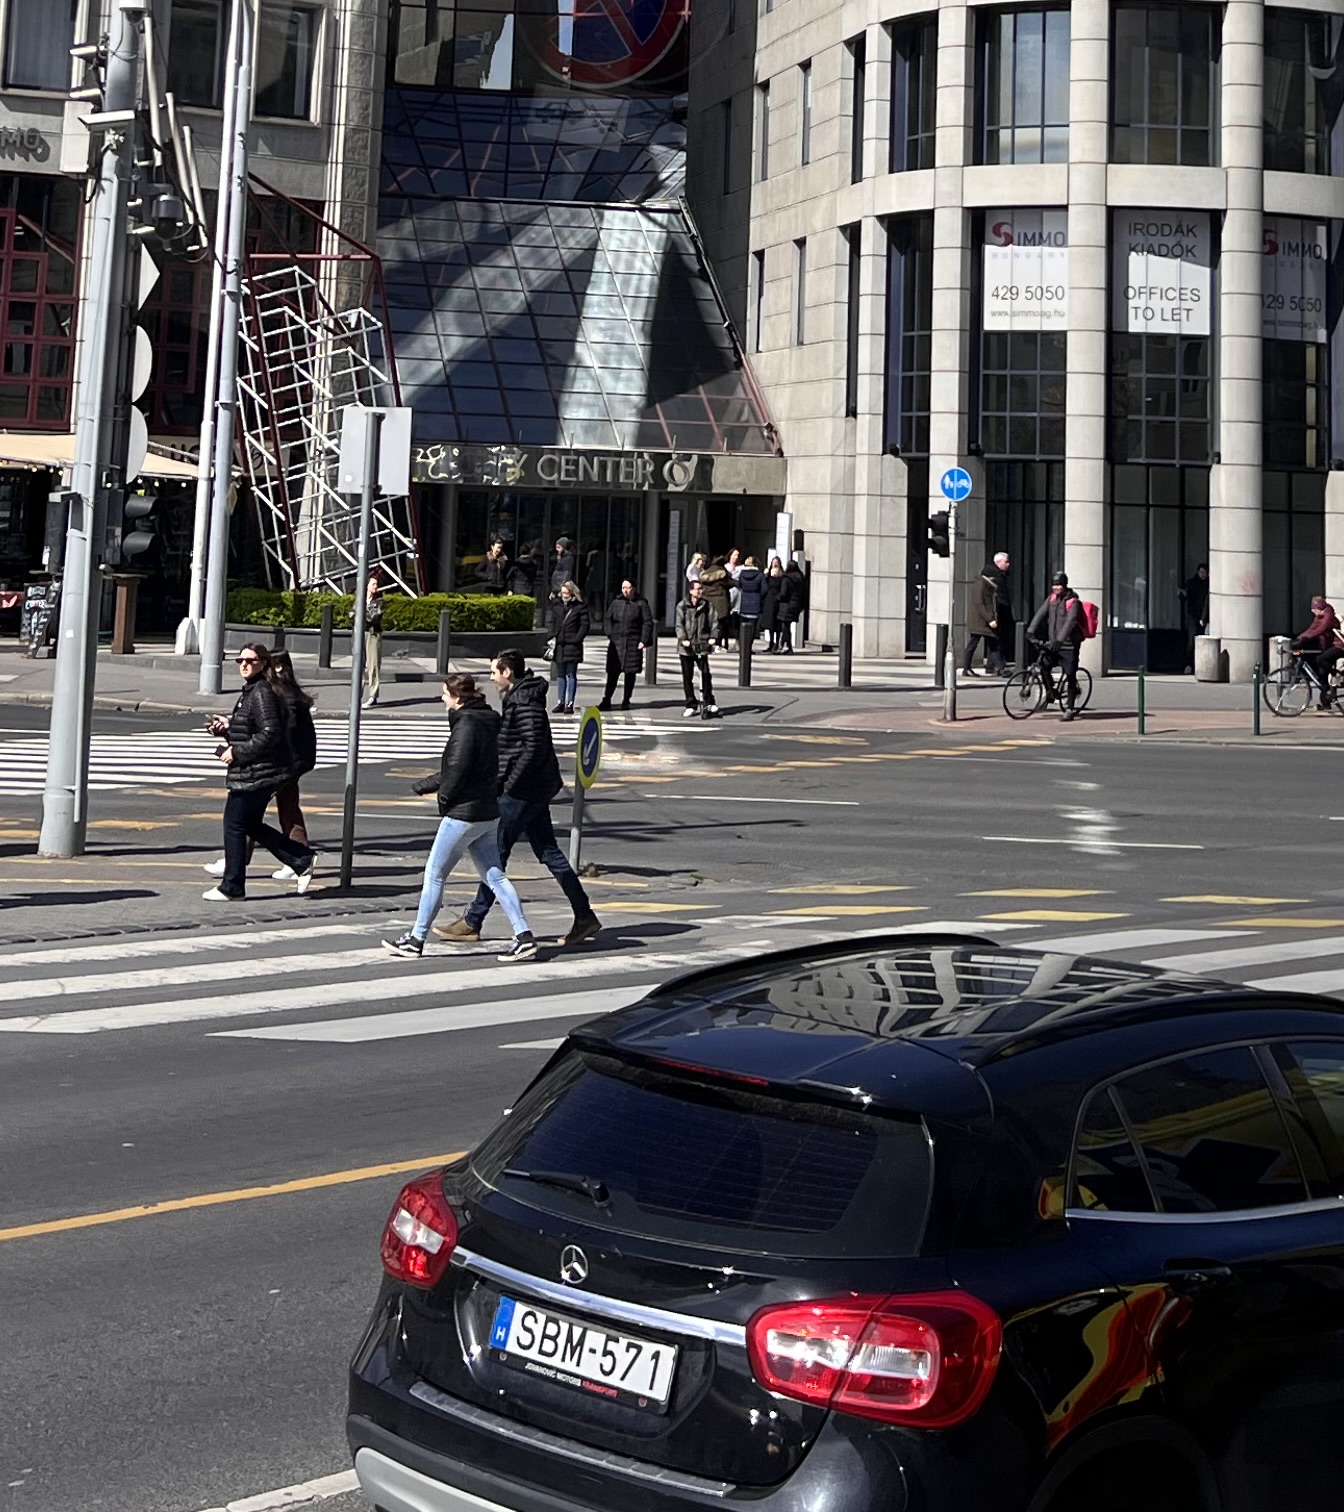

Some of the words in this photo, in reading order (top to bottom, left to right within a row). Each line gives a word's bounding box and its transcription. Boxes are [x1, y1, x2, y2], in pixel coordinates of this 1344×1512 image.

[1128, 220, 1198, 238] IRODÁK
[1128, 241, 1197, 258] KIADÓK
[991, 285, 1020, 301] 429
[1024, 285, 1066, 301] 5050
[1123, 285, 1201, 302] OFFICES
[1262, 294, 1285, 310] 29
[1131, 306, 1155, 321] TO
[1160, 307, 1194, 322] LET
[536, 453, 655, 484] CENTER
[495, 1326, 507, 1342] H
[516, 1310, 661, 1391] SBM-571
